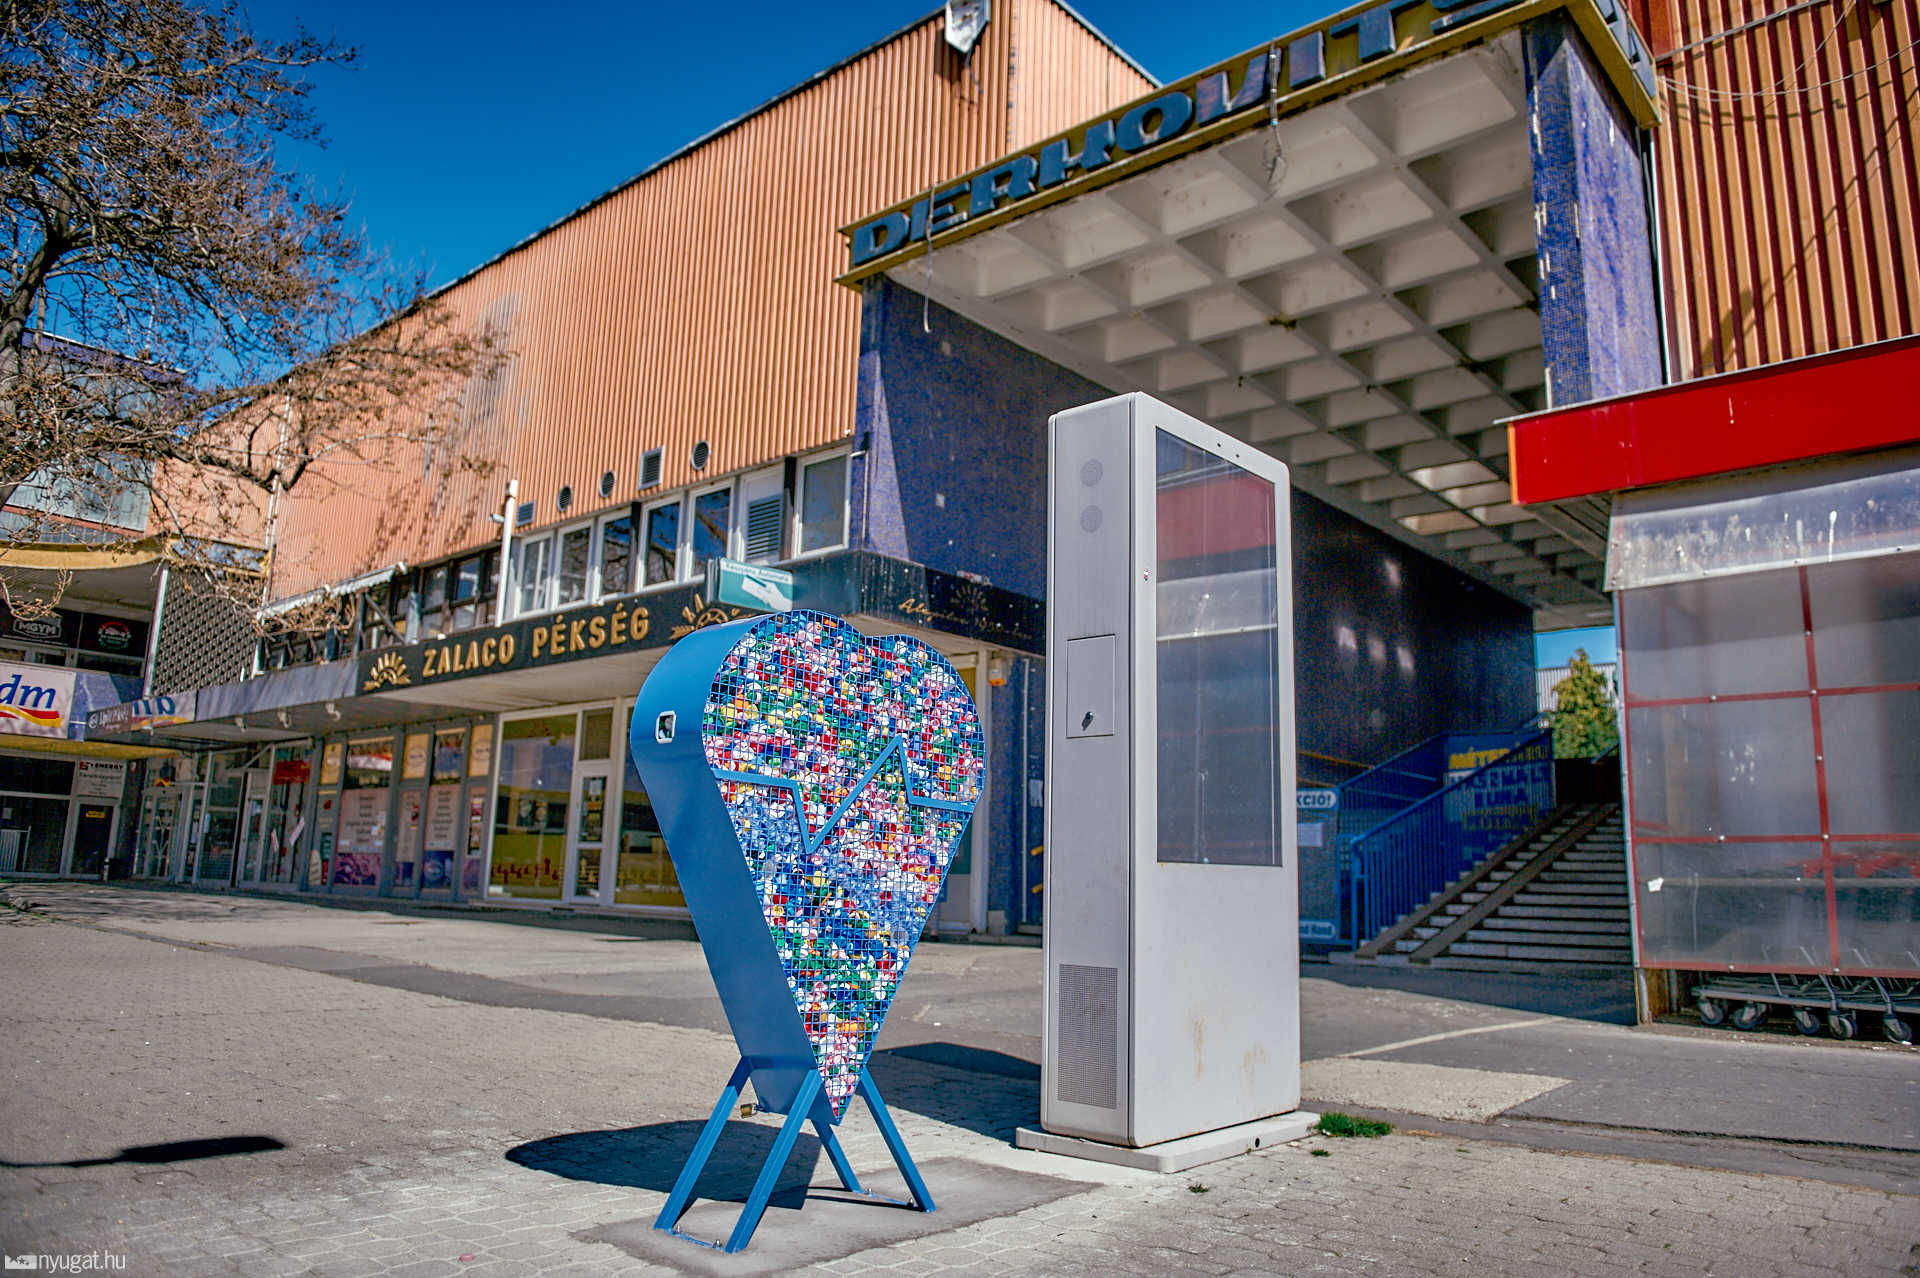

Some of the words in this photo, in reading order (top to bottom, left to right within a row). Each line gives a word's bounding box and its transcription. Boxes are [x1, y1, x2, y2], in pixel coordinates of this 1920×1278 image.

[422, 634, 515, 677] ZALACO
[531, 602, 649, 659] PÉKSÉG
[0, 674, 56, 708] dm
